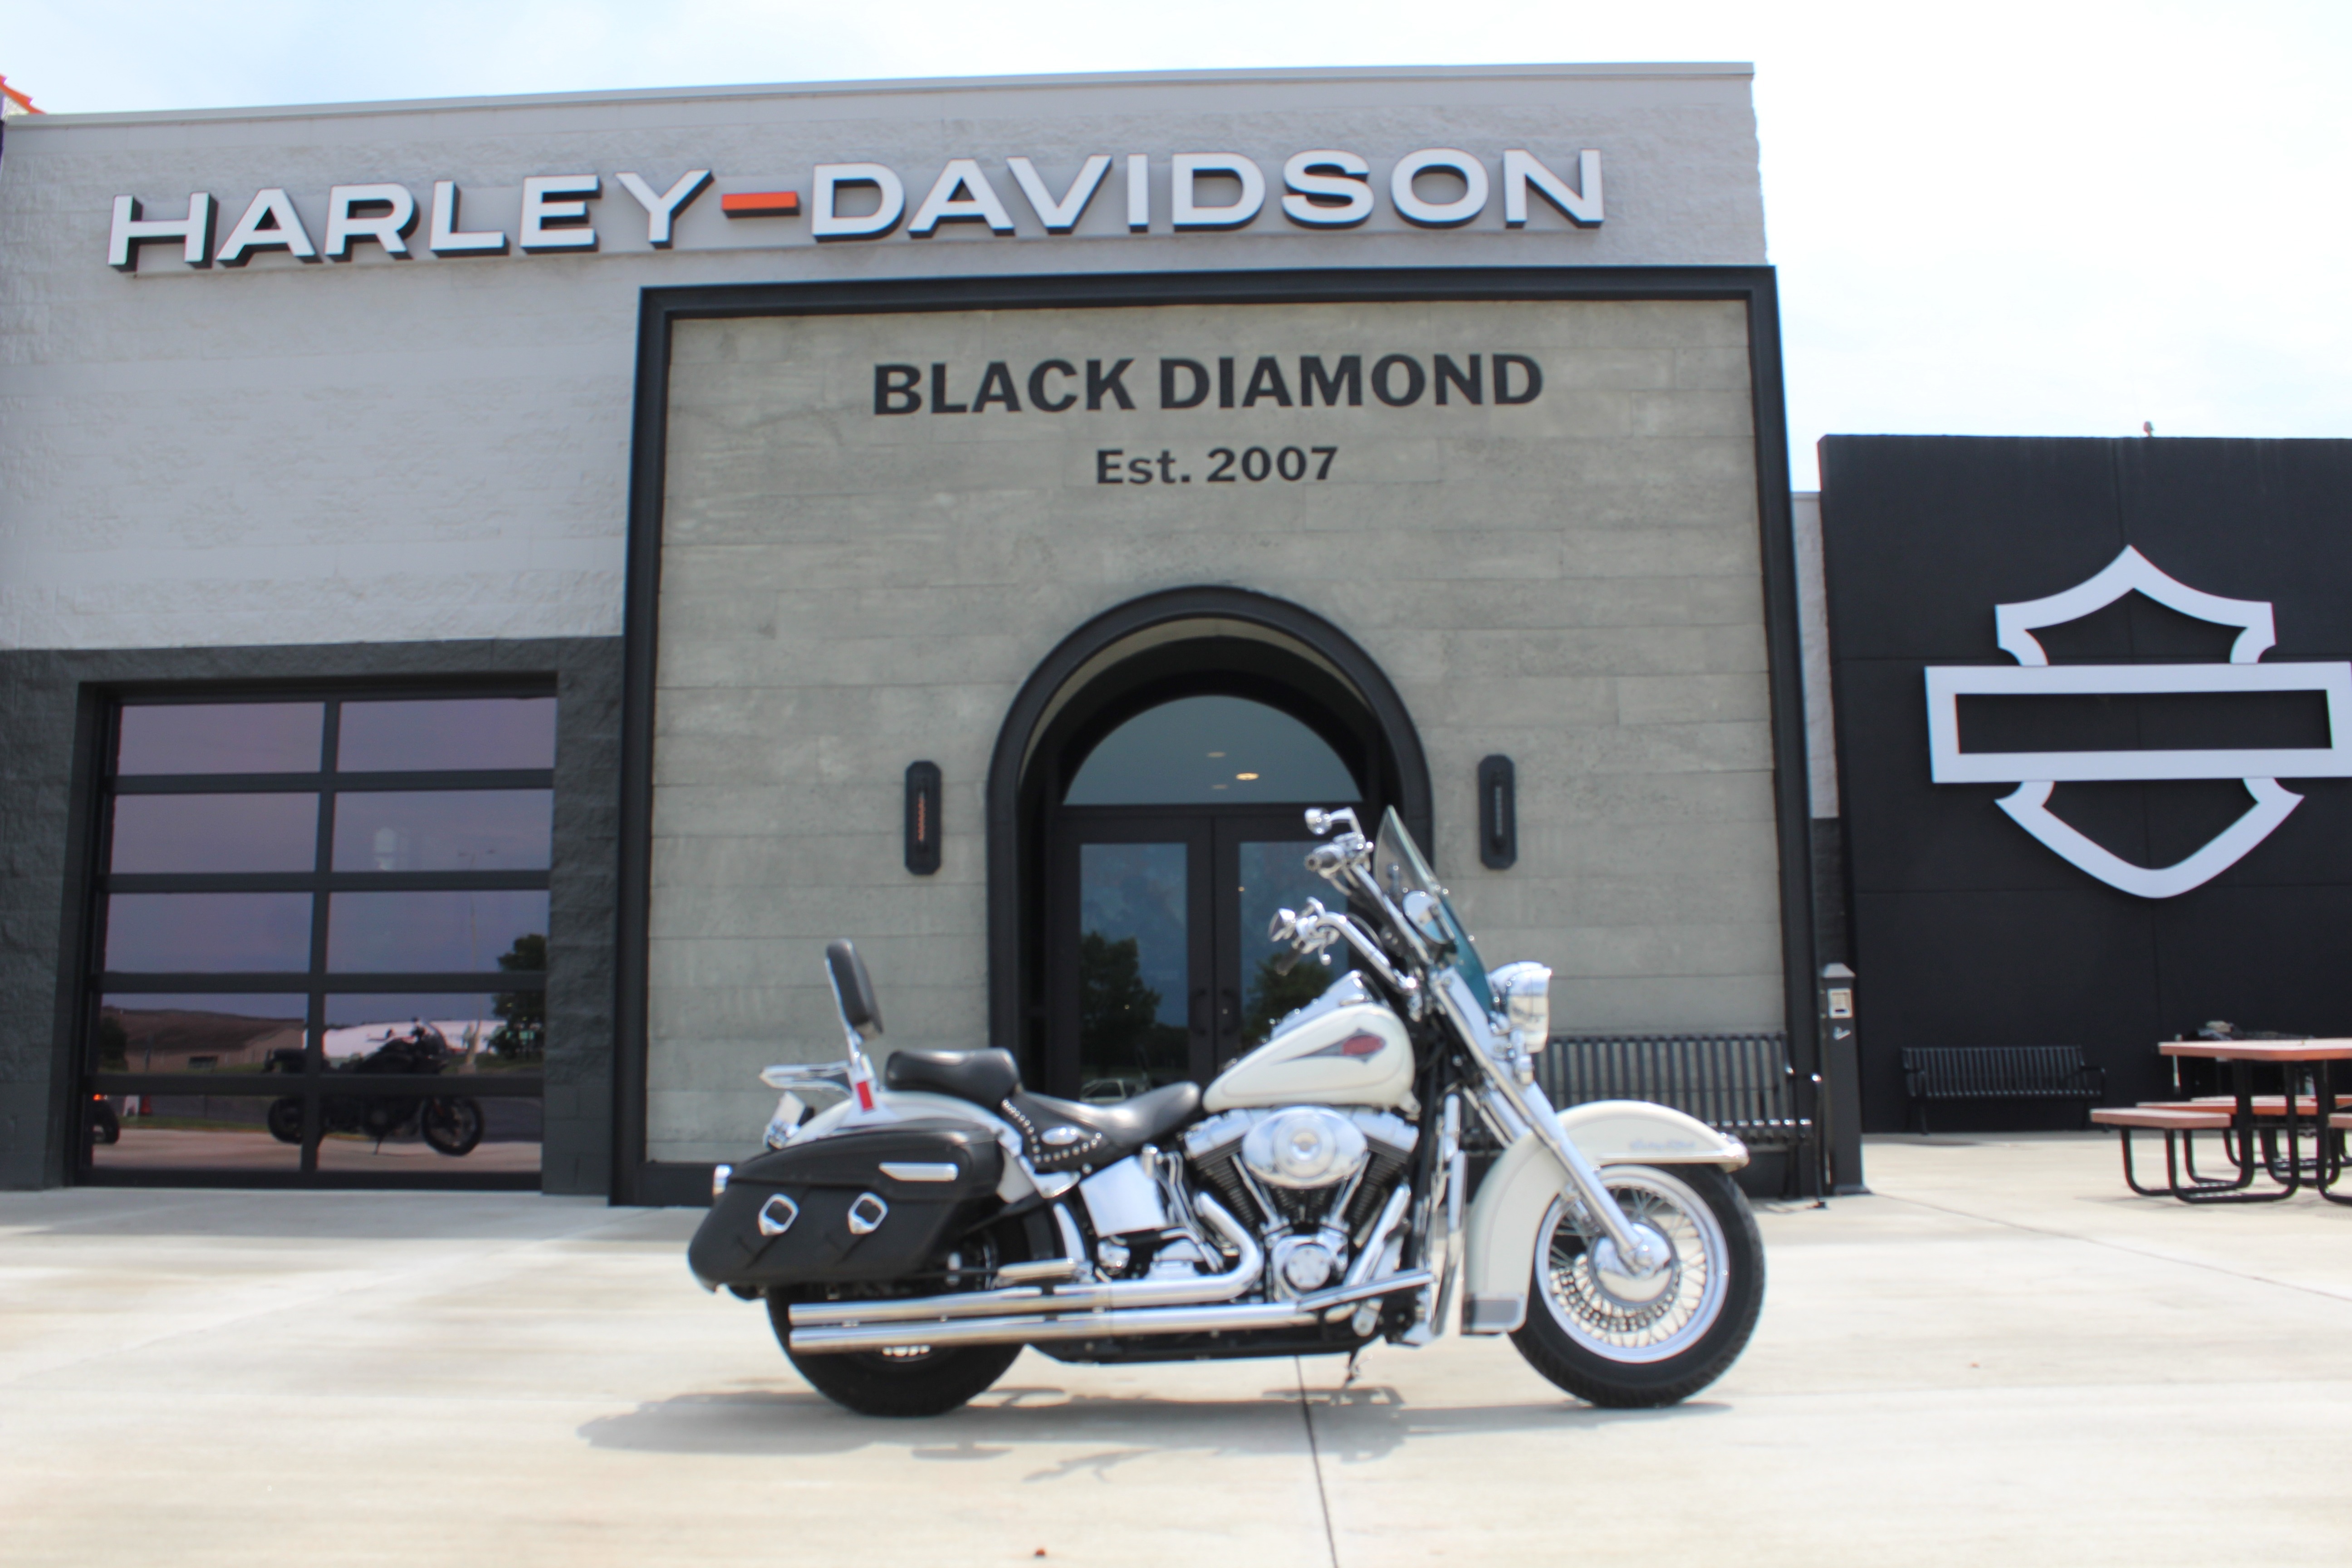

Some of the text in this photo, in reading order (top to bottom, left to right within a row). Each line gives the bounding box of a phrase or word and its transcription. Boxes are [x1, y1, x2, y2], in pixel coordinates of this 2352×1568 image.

[107, 147, 1605, 270] HARLEY-DAVIDSON
[873, 353, 1543, 416] BLACK DIAMOND
[1096, 446, 1338, 485] Est. 2007
